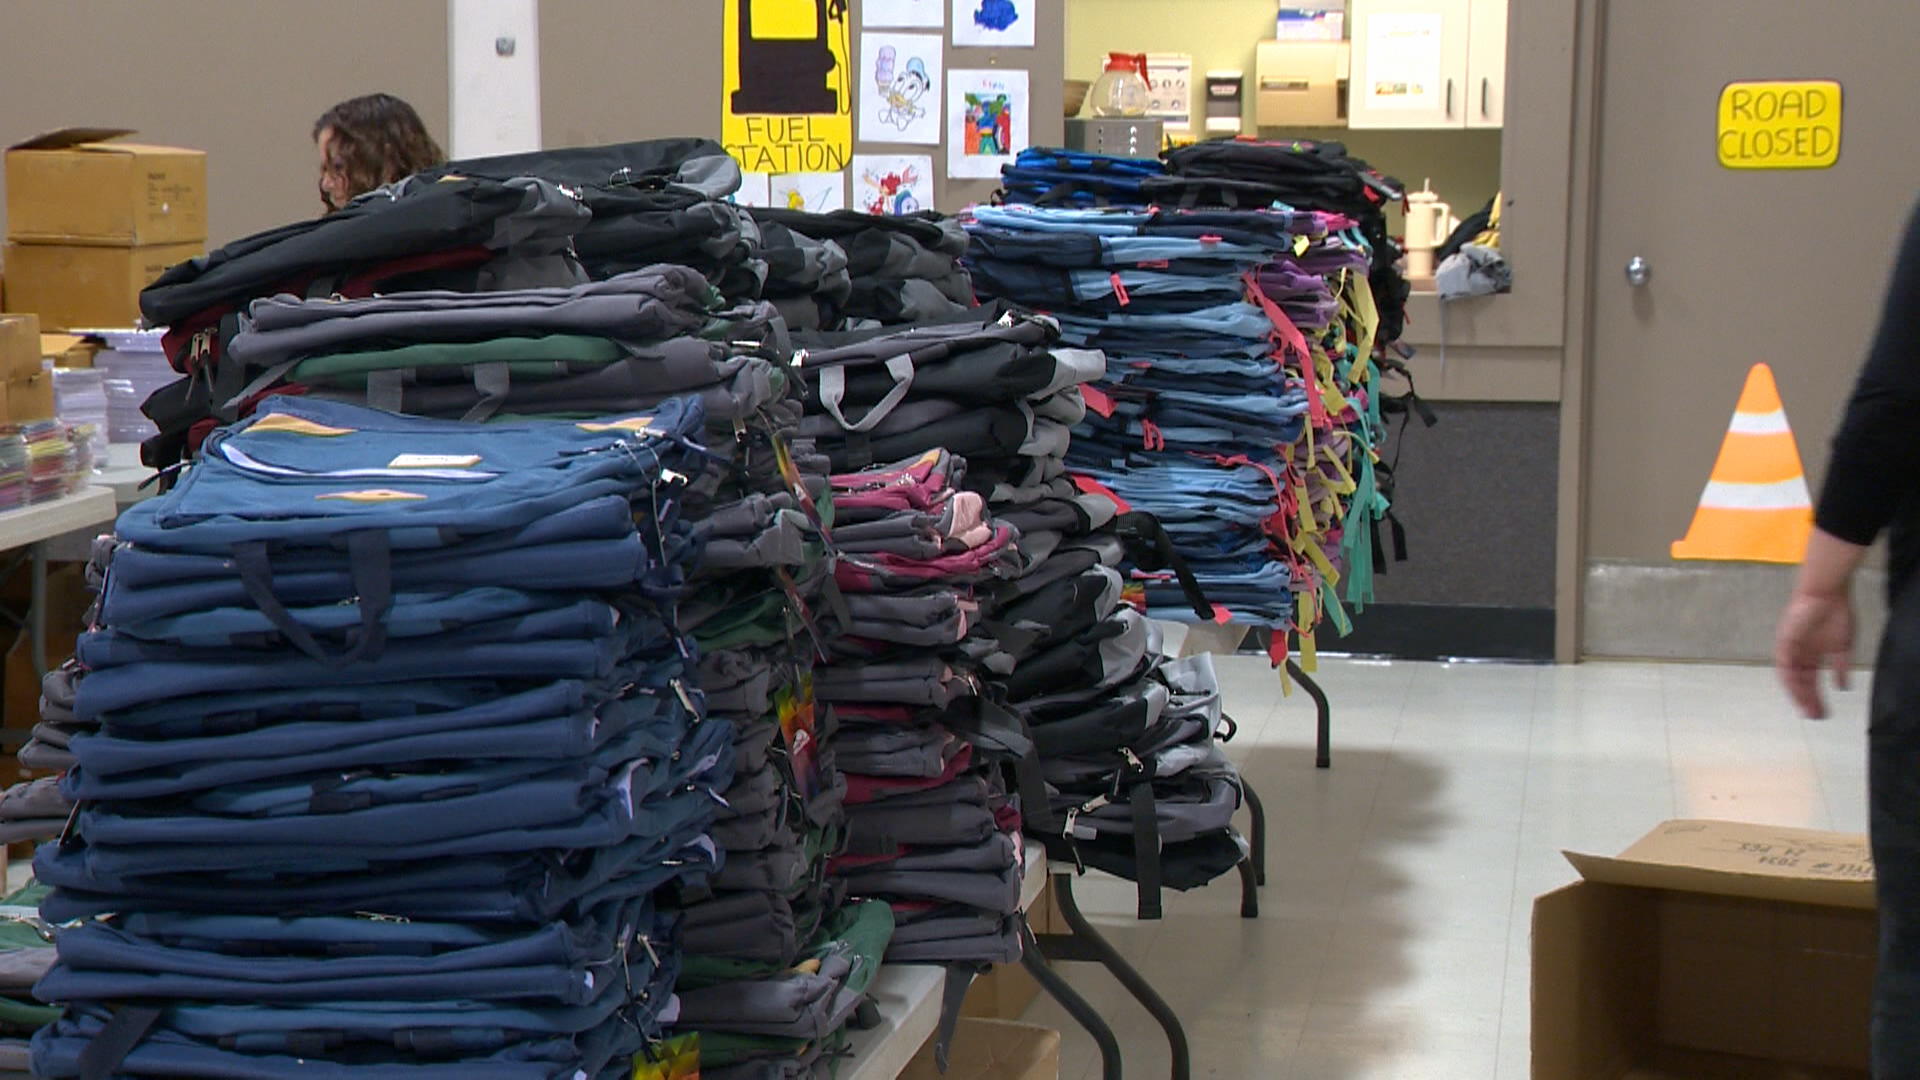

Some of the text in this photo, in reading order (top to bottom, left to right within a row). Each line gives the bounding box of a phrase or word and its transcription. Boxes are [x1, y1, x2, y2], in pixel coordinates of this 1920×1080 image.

[1731, 89, 1827, 121] ROAD
[746, 116, 825, 143] FUEL
[1720, 125, 1833, 159] CLOSED
